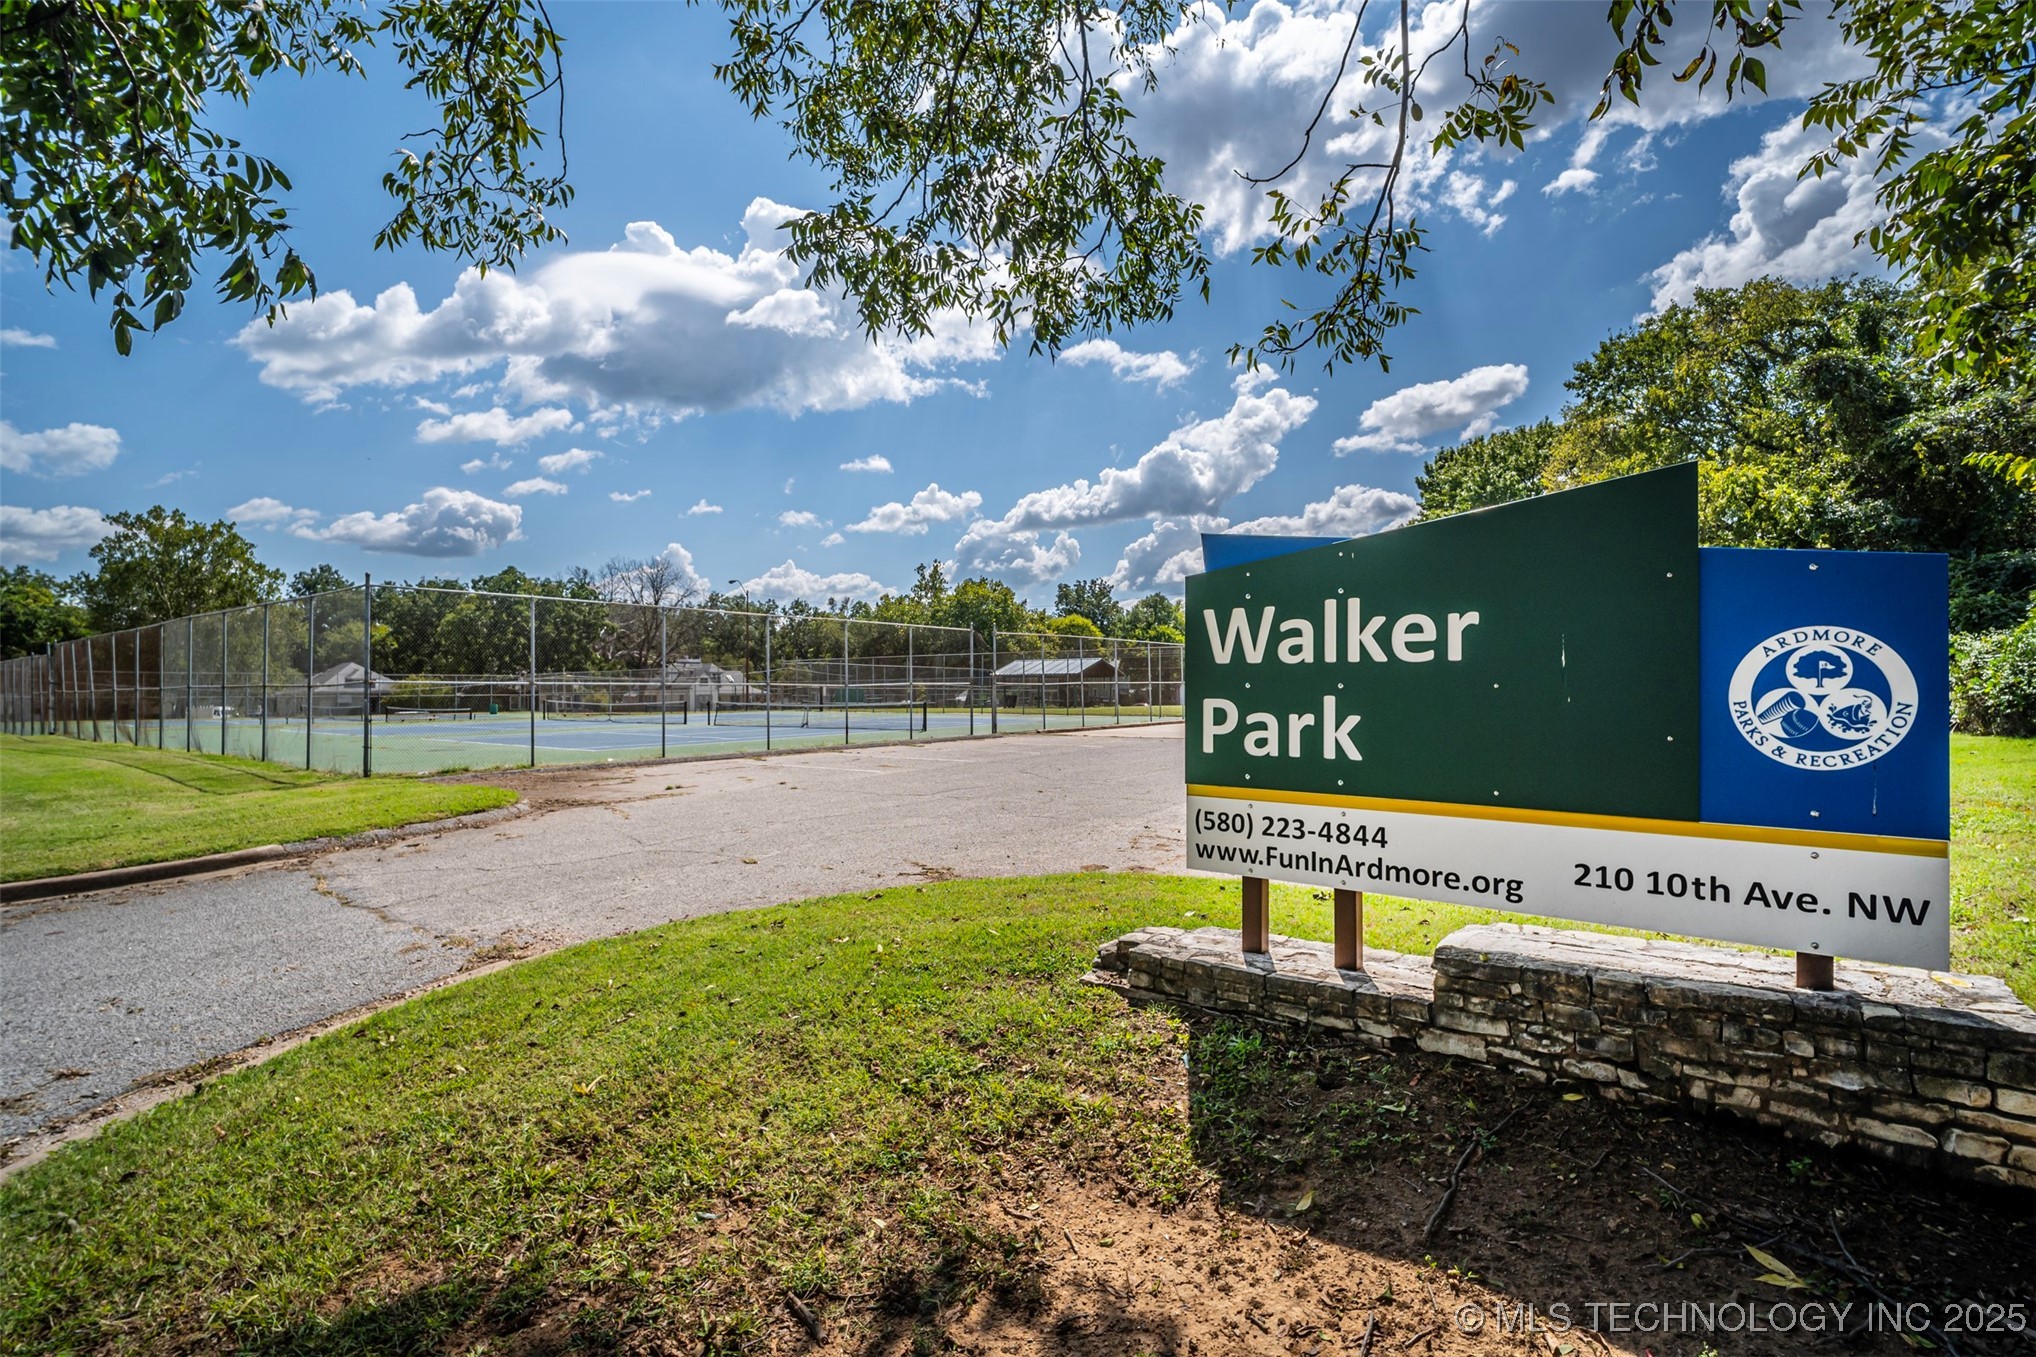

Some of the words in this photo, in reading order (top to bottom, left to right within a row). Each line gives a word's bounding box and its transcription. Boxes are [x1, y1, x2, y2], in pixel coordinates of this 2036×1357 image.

[1203, 598, 1481, 664] Walker
[1762, 629, 1883, 657] ARDMORE
[1202, 695, 1363, 761] Park
[1733, 700, 1769, 747] PARKS
[1771, 745, 1787, 759] &
[1795, 701, 1913, 768] RECREATION
[1195, 809, 1254, 839] (580)
[1262, 816, 1388, 849] 223-4844
[1195, 842, 1524, 904] www.FunInArdmore.org
[1574, 863, 1634, 892] 210
[1647, 870, 1731, 902] 10th
[1743, 882, 1831, 915] Ave.
[1848, 892, 1931, 926] NW
